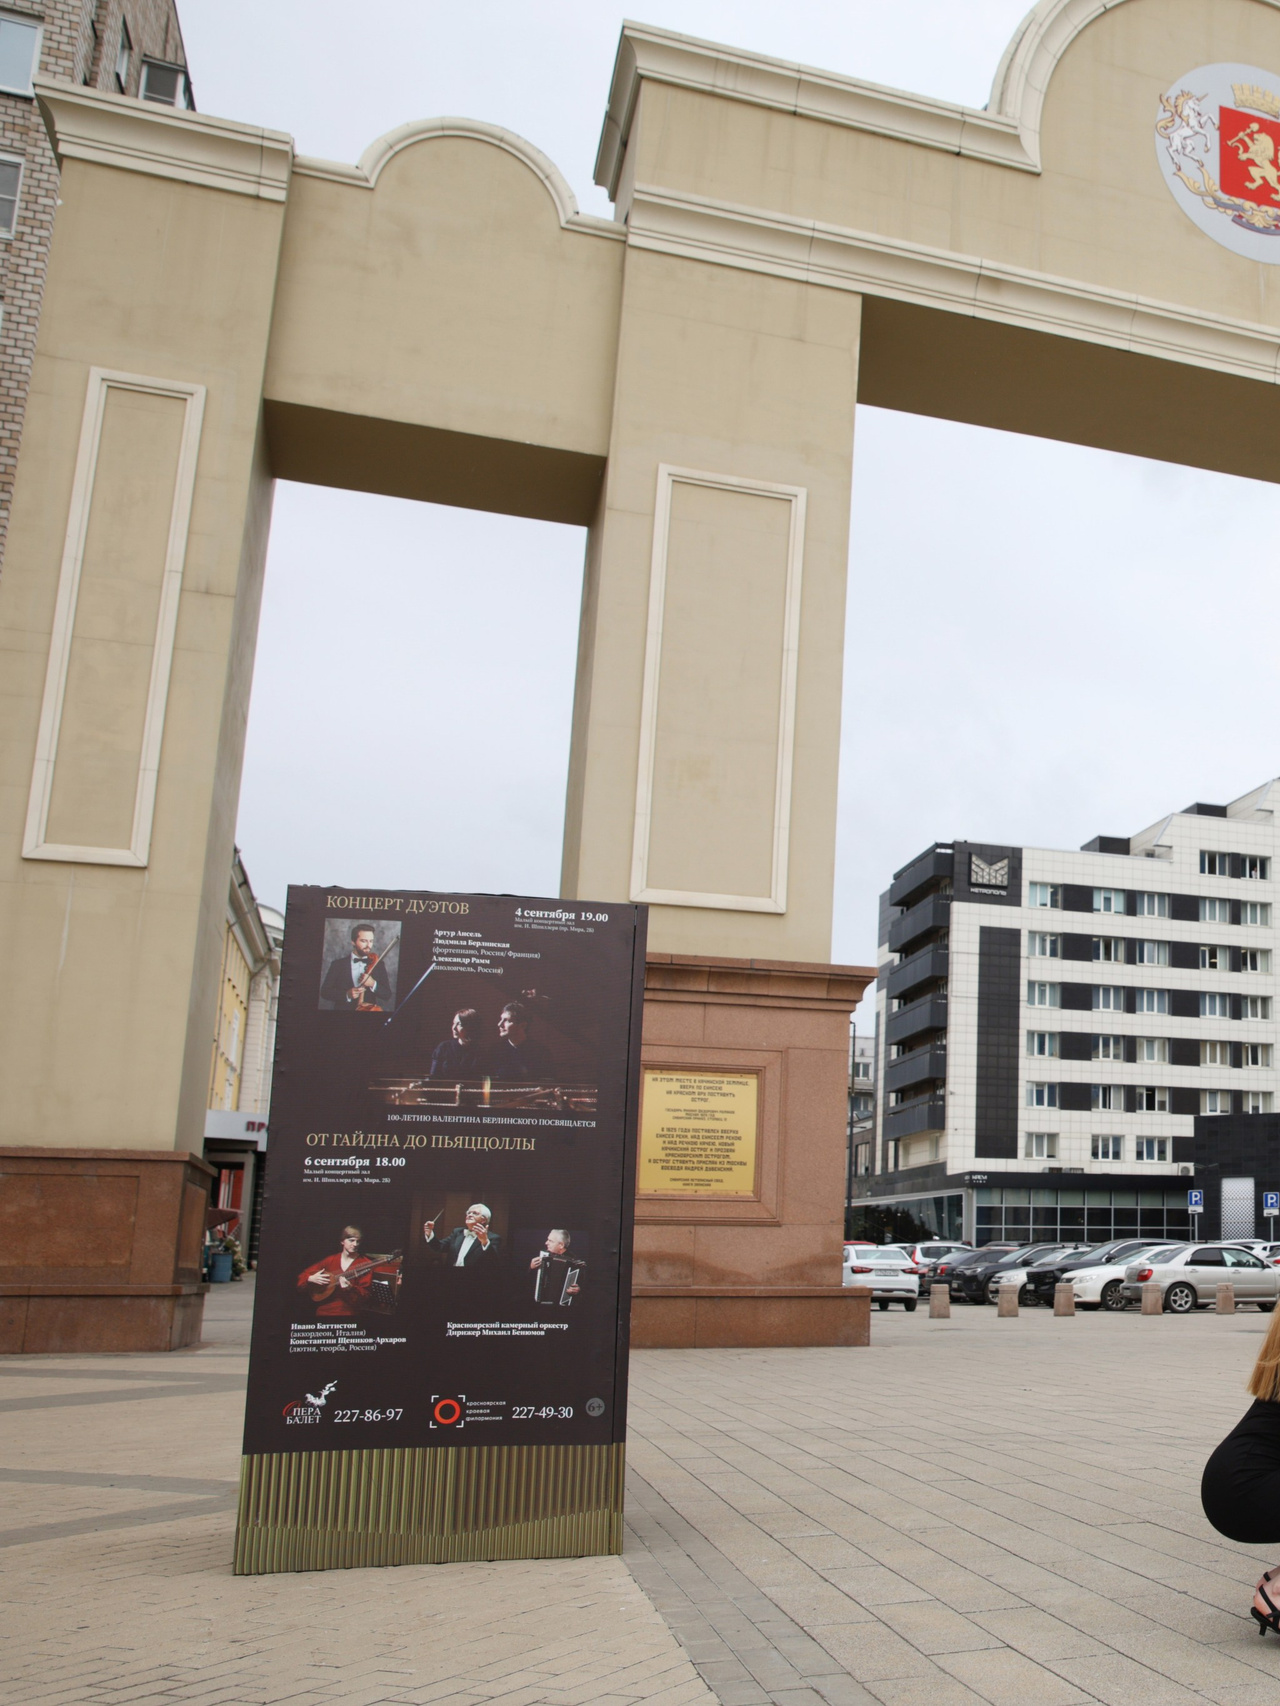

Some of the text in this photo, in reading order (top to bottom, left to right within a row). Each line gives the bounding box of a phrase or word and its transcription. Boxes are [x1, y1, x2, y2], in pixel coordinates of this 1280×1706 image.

[326, 896, 470, 914] КОНЦЕРТ ДУЭТОВ
[515, 907, 609, 922] 4 сентября 19.00
[434, 929, 456, 938] Артур
[433, 938, 510, 949] Людмила Берлинская
[432, 947, 479, 956] (фортепиано,
[507, 950, 541, 959] Франция)
[432, 955, 470, 964] Александр
[477, 966, 504, 975] Россия)
[387, 1114, 596, 1128] 100-ЛЕТИЮ ВАЛЕНТИНА БЕРЛИНСКОГО ПОСВЯЩАЕТСЯ
[306, 1130, 536, 1151] ОТ ГАЙДНА ДО ПЬЯЦЦОЛЛЫ
[304, 1156, 406, 1168] 6 сентября 18.00
[290, 1330, 334, 1338] (аккордеон,
[446, 1329, 481, 1337] Дирижер
[338, 1337, 406, 1345] Щеников-Архаров
[289, 1345, 318, 1353] (лютня,
[320, 1345, 348, 1353] теорба,
[587, 1402, 603, 1412] 6+
[334, 1409, 403, 1423] 227-86-97
[512, 1406, 573, 1419] 227-49-30
[286, 1416, 322, 1424] БАЛЕТ
